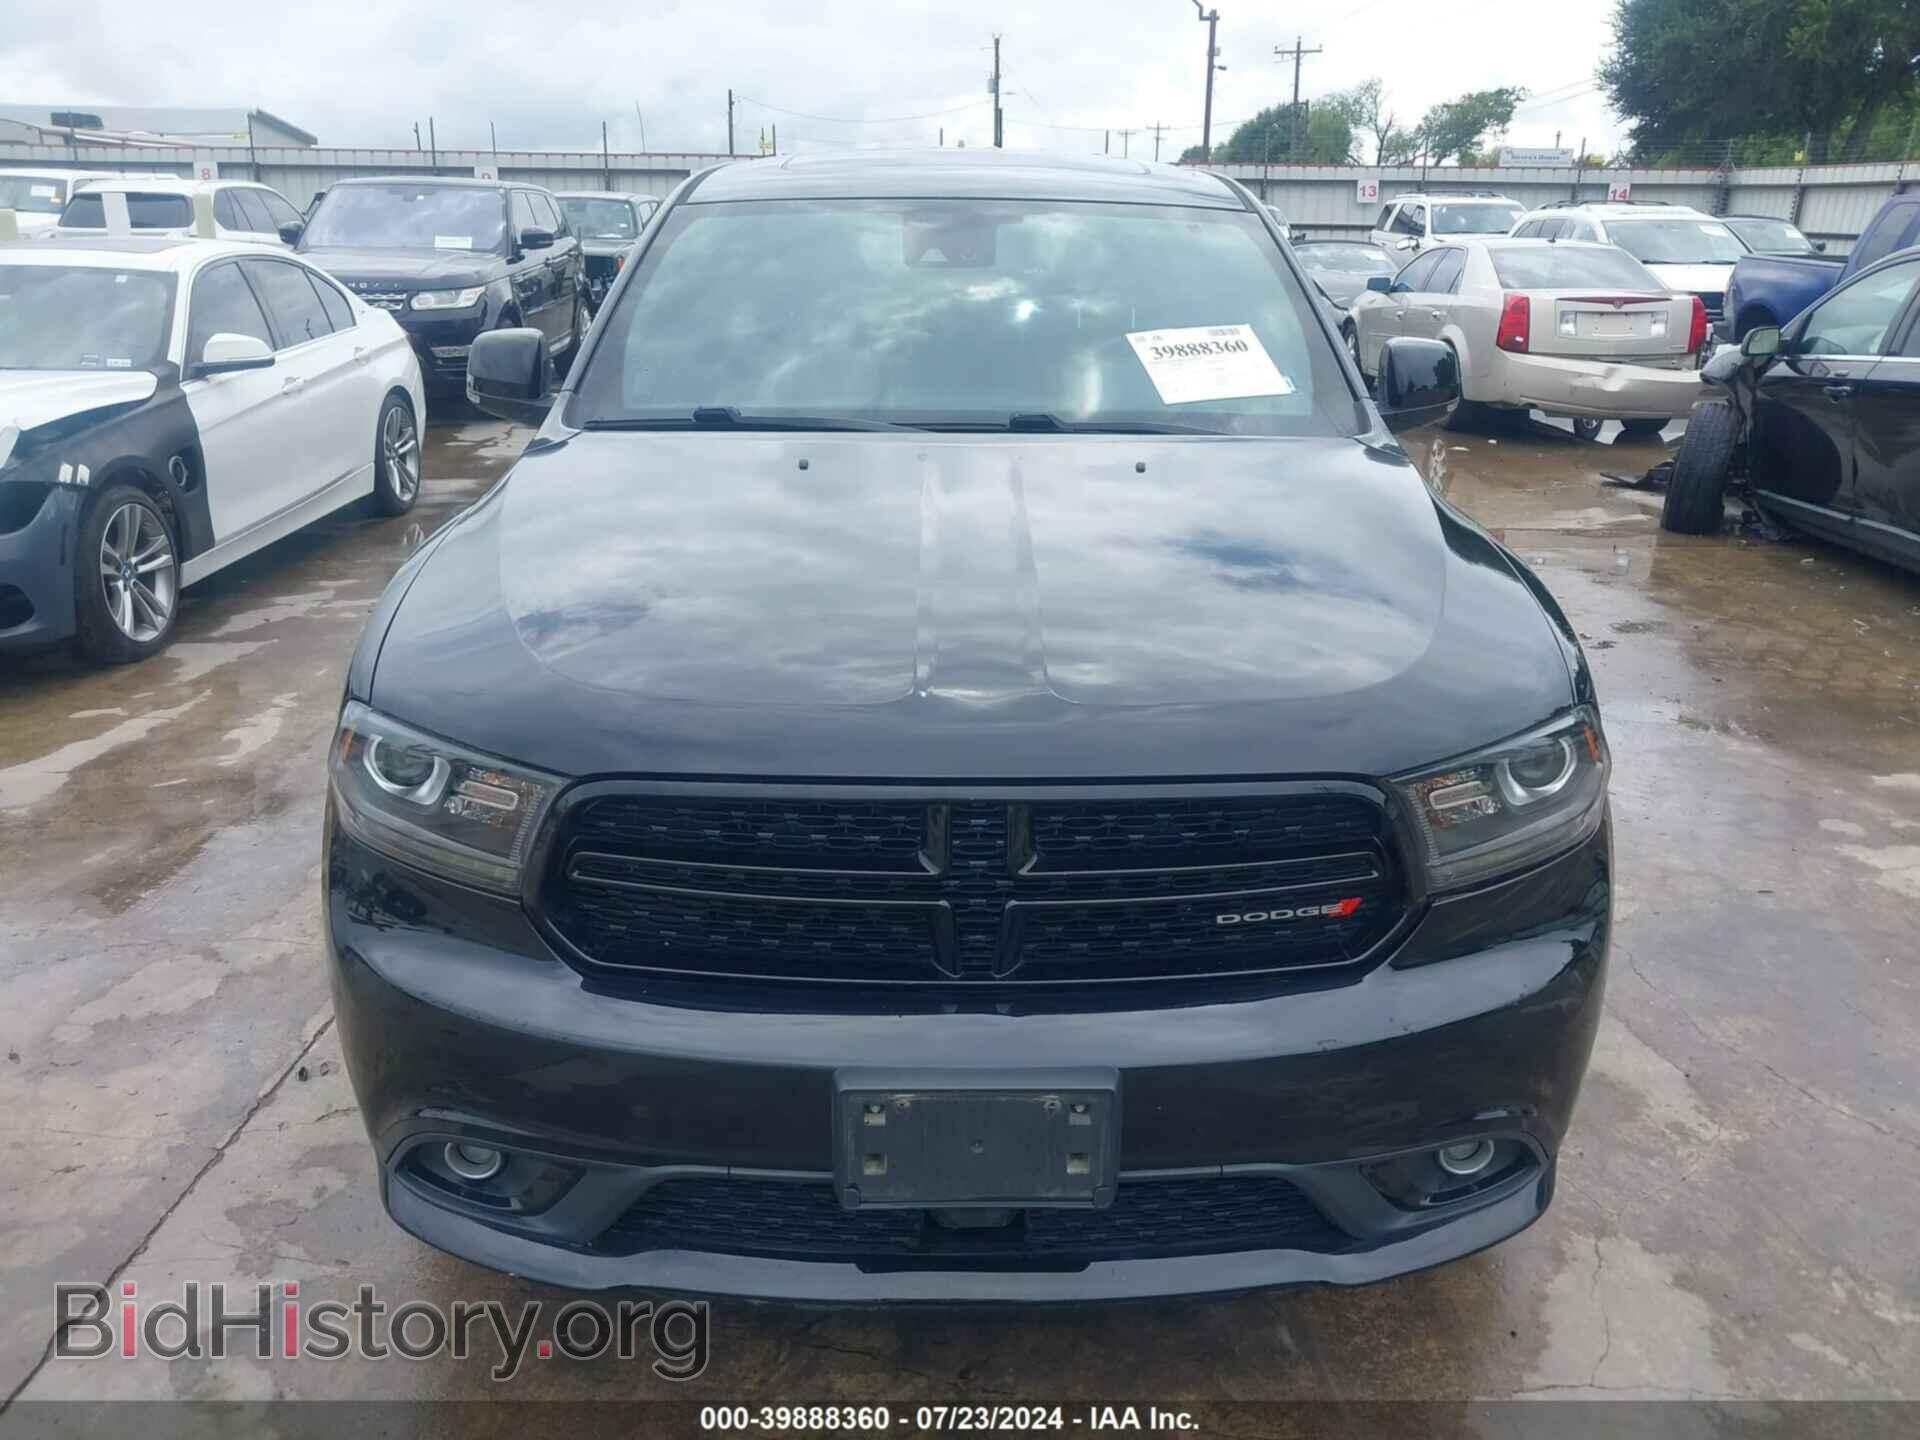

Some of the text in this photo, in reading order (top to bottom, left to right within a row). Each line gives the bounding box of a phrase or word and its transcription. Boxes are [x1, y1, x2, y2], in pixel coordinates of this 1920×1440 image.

[1360, 185, 1377, 197] 13
[1610, 189, 1628, 200] 14
[1150, 339, 1249, 360] 39888360
[1216, 903, 1345, 924] DODGE
